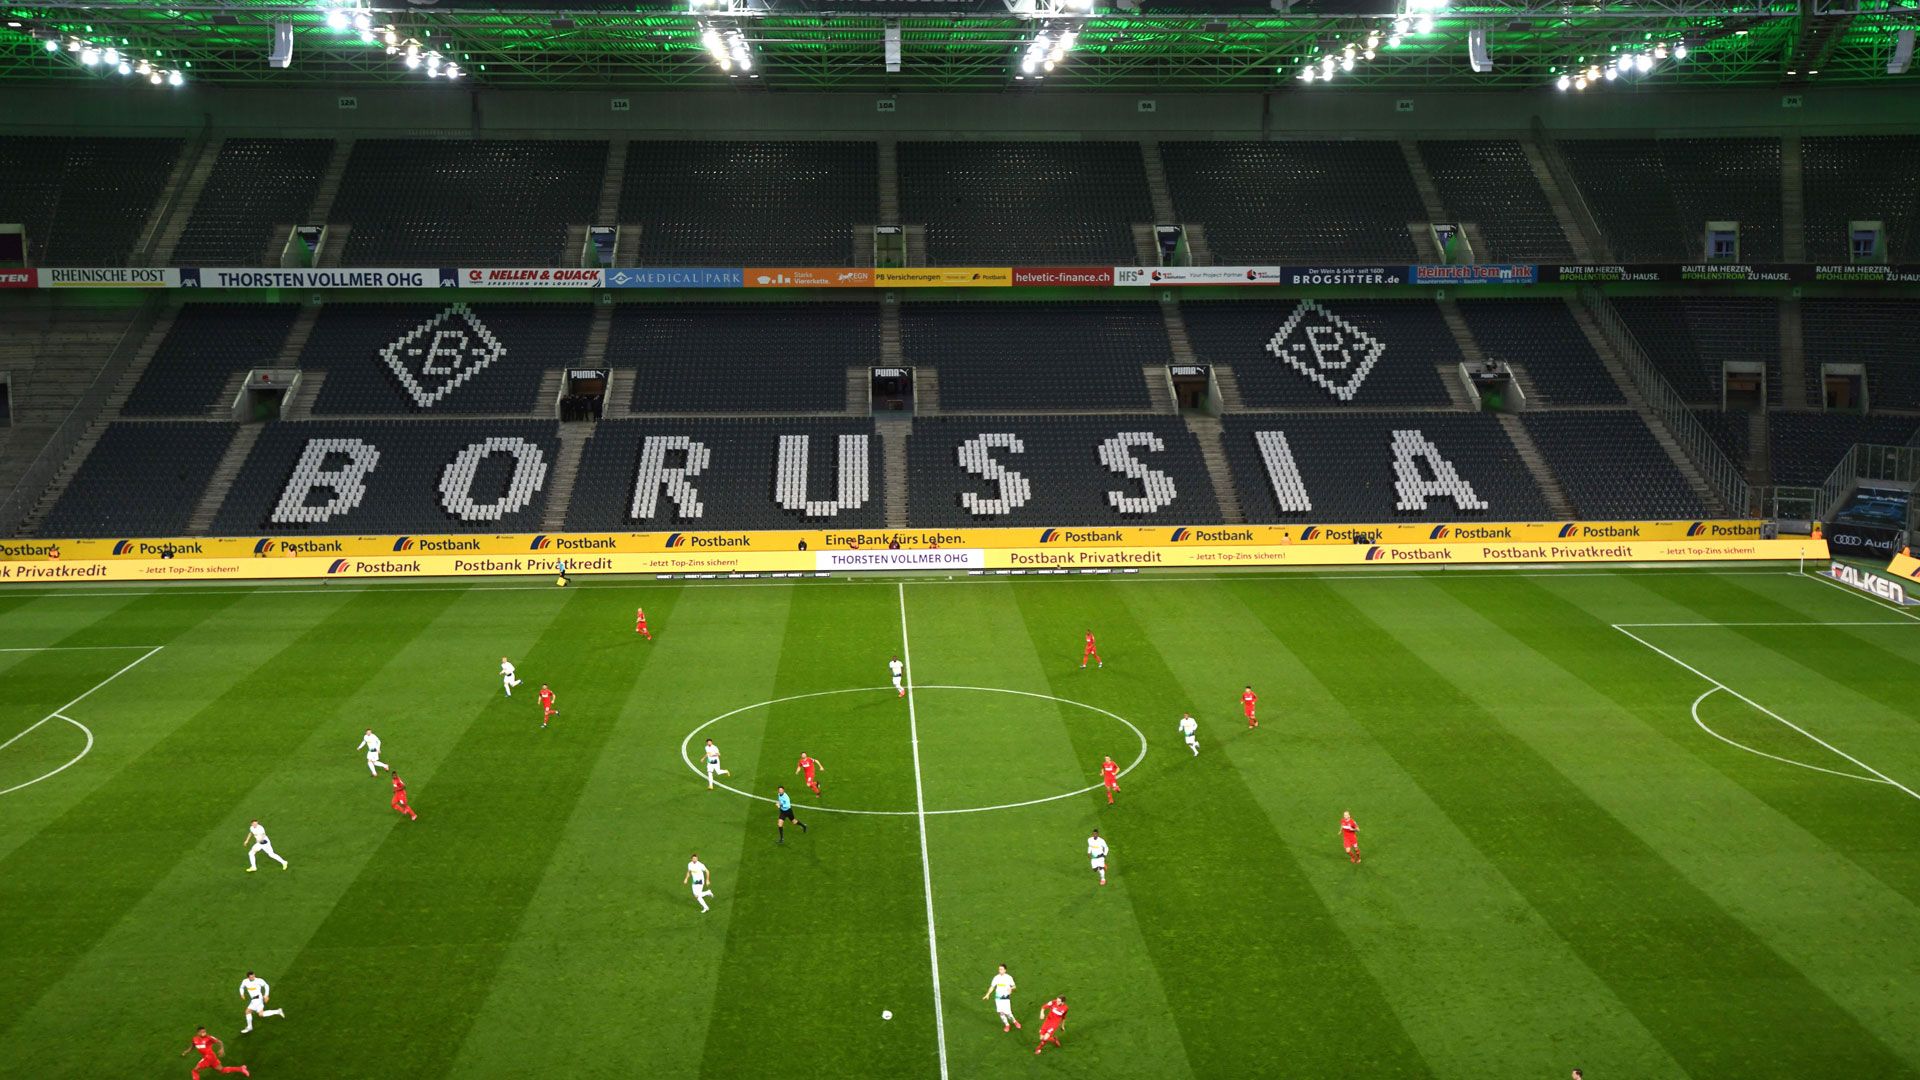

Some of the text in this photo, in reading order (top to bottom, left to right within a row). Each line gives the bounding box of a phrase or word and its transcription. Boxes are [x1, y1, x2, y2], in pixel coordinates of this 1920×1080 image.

[489, 270, 600, 281] NELLEN & QUACK
[1417, 266, 1472, 278] Heinrich
[1559, 266, 1627, 275] RAUTE IM HERZEN,
[1681, 265, 1754, 274] RAUTE IM HERZEN,
[1816, 265, 1892, 274] RAUTE IM HERZEN,
[0, 274, 29, 283] TEN
[51, 269, 166, 283] RHEINISCHE POST
[218, 272, 423, 287] THORSTEN VOLLMER OHG
[635, 273, 741, 283] MEDICAL PARK
[887, 273, 941, 282] Versicherungen
[1015, 272, 1110, 283] helvetic-finance.ch
[1119, 271, 1138, 282] HFS
[1293, 275, 1400, 284] BROGSITTER.de
[1559, 273, 1660, 281] #FOHLENSTROM ZU HAUSE.
[1747, 273, 1759, 281] ZU
[1761, 273, 1791, 281] HAUSE.
[1816, 273, 1920, 281] #FOHLENSTROM ZU HAU
[181, 278, 198, 287] AXA
[439, 278, 457, 287] AXA
[875, 368, 899, 378] PUMA
[270, 429, 1489, 524] BORUSSIA
[1065, 530, 1123, 543] Postbank
[1196, 529, 1254, 542] Postbank
[1455, 527, 1512, 540] Postbank
[1583, 525, 1641, 538] Postbank
[1711, 524, 1761, 537] Postban
[419, 538, 481, 551] Postbank
[556, 537, 617, 549] Postbank
[691, 535, 751, 548] Postbank
[857, 533, 889, 545] Bank
[922, 532, 966, 545] Leben.
[1864, 538, 1893, 549] Audi
[140, 541, 203, 555] Postbank
[281, 540, 343, 553] Postbank
[1666, 546, 1756, 557] Jetzt Top-Zins sichern!
[1010, 551, 1162, 566] Postbank Privatkredit
[1196, 552, 1286, 564] Jetzt Top-Zins sichern!
[1391, 548, 1452, 561] Postbank
[1483, 546, 1633, 560] Postbank Privatkredit
[454, 558, 613, 572] Postbank Privatkredit
[649, 558, 739, 570] Jetzt Top-Zins sichern!
[832, 553, 969, 566] THORSTEN VOLLMER OHG
[16, 564, 108, 578] Privatkredit
[145, 565, 240, 576] Jetzt Top-Zins sichern!
[356, 560, 421, 574] Postbank
[1831, 561, 1905, 606] FALKEN
